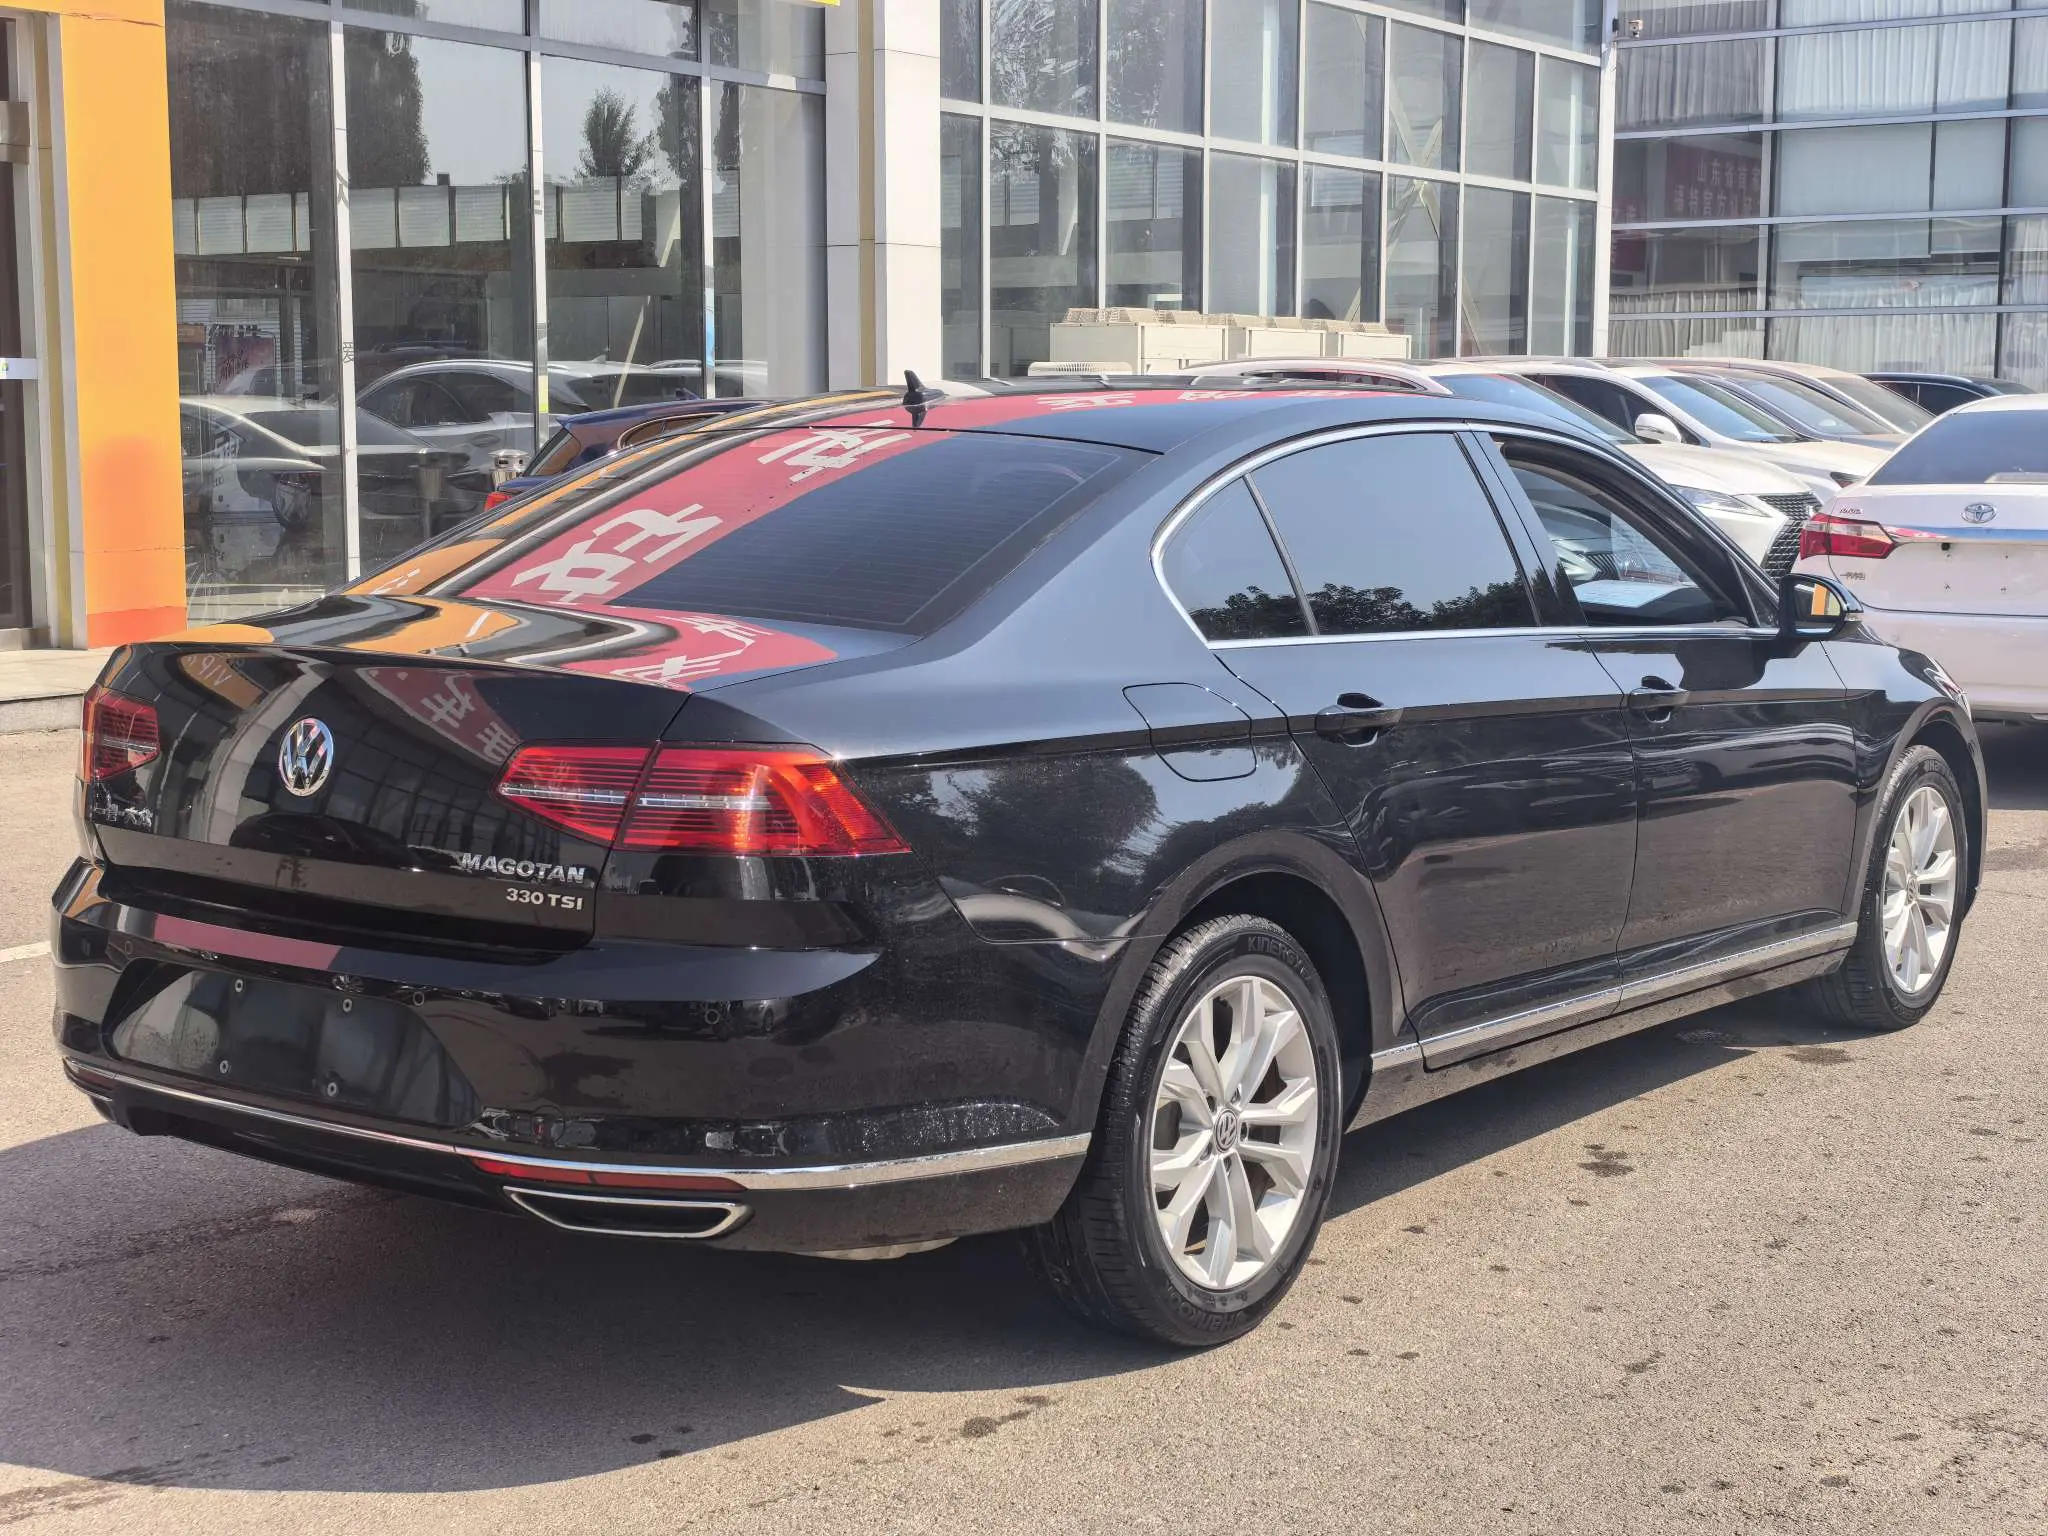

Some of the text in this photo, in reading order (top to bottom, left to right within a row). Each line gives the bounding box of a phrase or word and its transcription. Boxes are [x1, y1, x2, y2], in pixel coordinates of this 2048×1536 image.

[461, 852, 585, 884] MAGOTAN
[506, 887, 583, 910] 330 TSI
